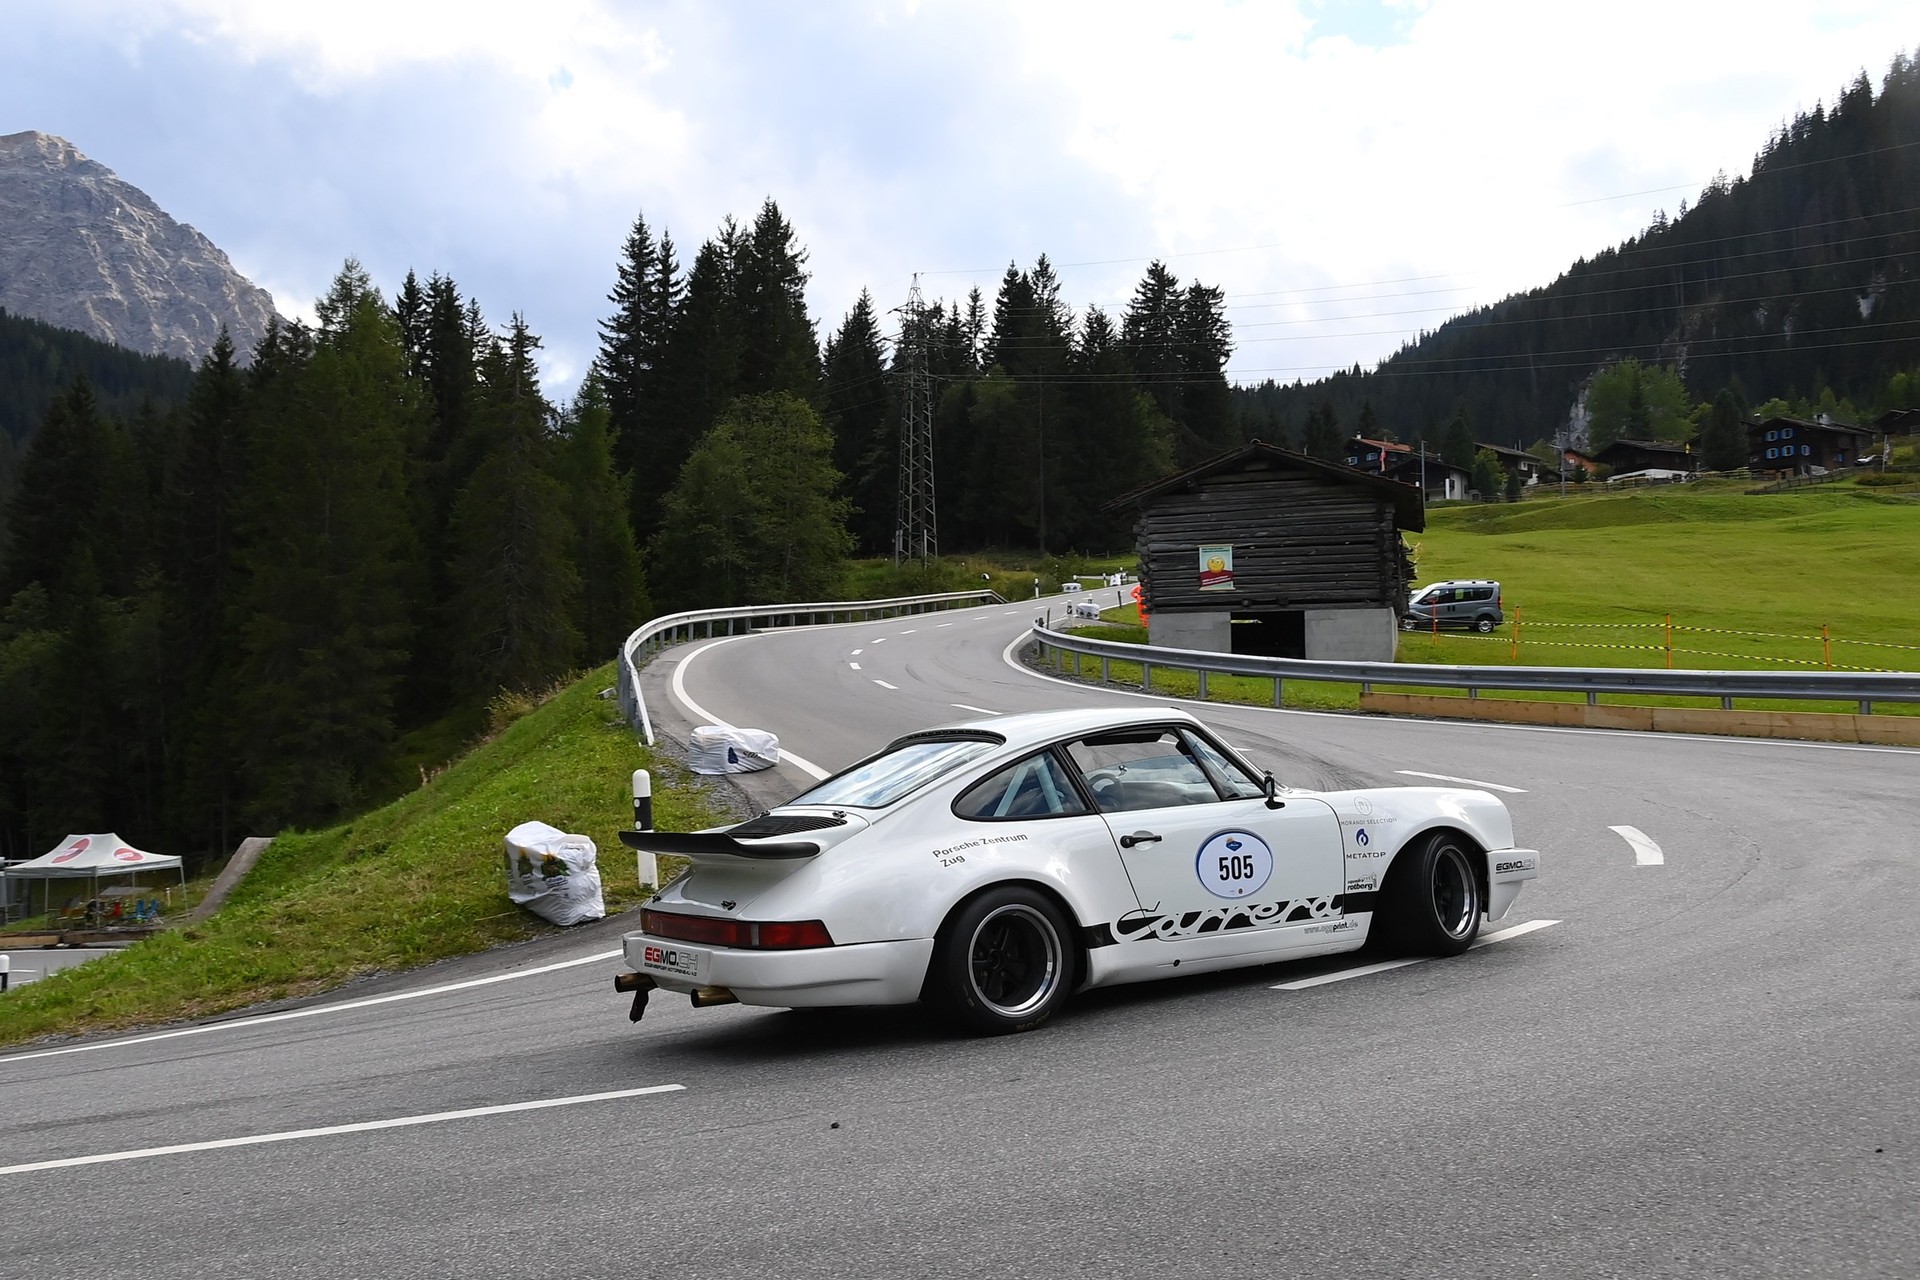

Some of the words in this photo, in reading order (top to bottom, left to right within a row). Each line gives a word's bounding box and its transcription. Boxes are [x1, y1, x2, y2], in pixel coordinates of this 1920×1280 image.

[932, 841, 980, 858] Porsche
[979, 833, 1028, 845] Zentrum
[1346, 851, 1386, 860] METATOP
[939, 855, 966, 868] Zug
[1219, 854, 1254, 881] 505
[1110, 895, 1343, 944] Carrera
